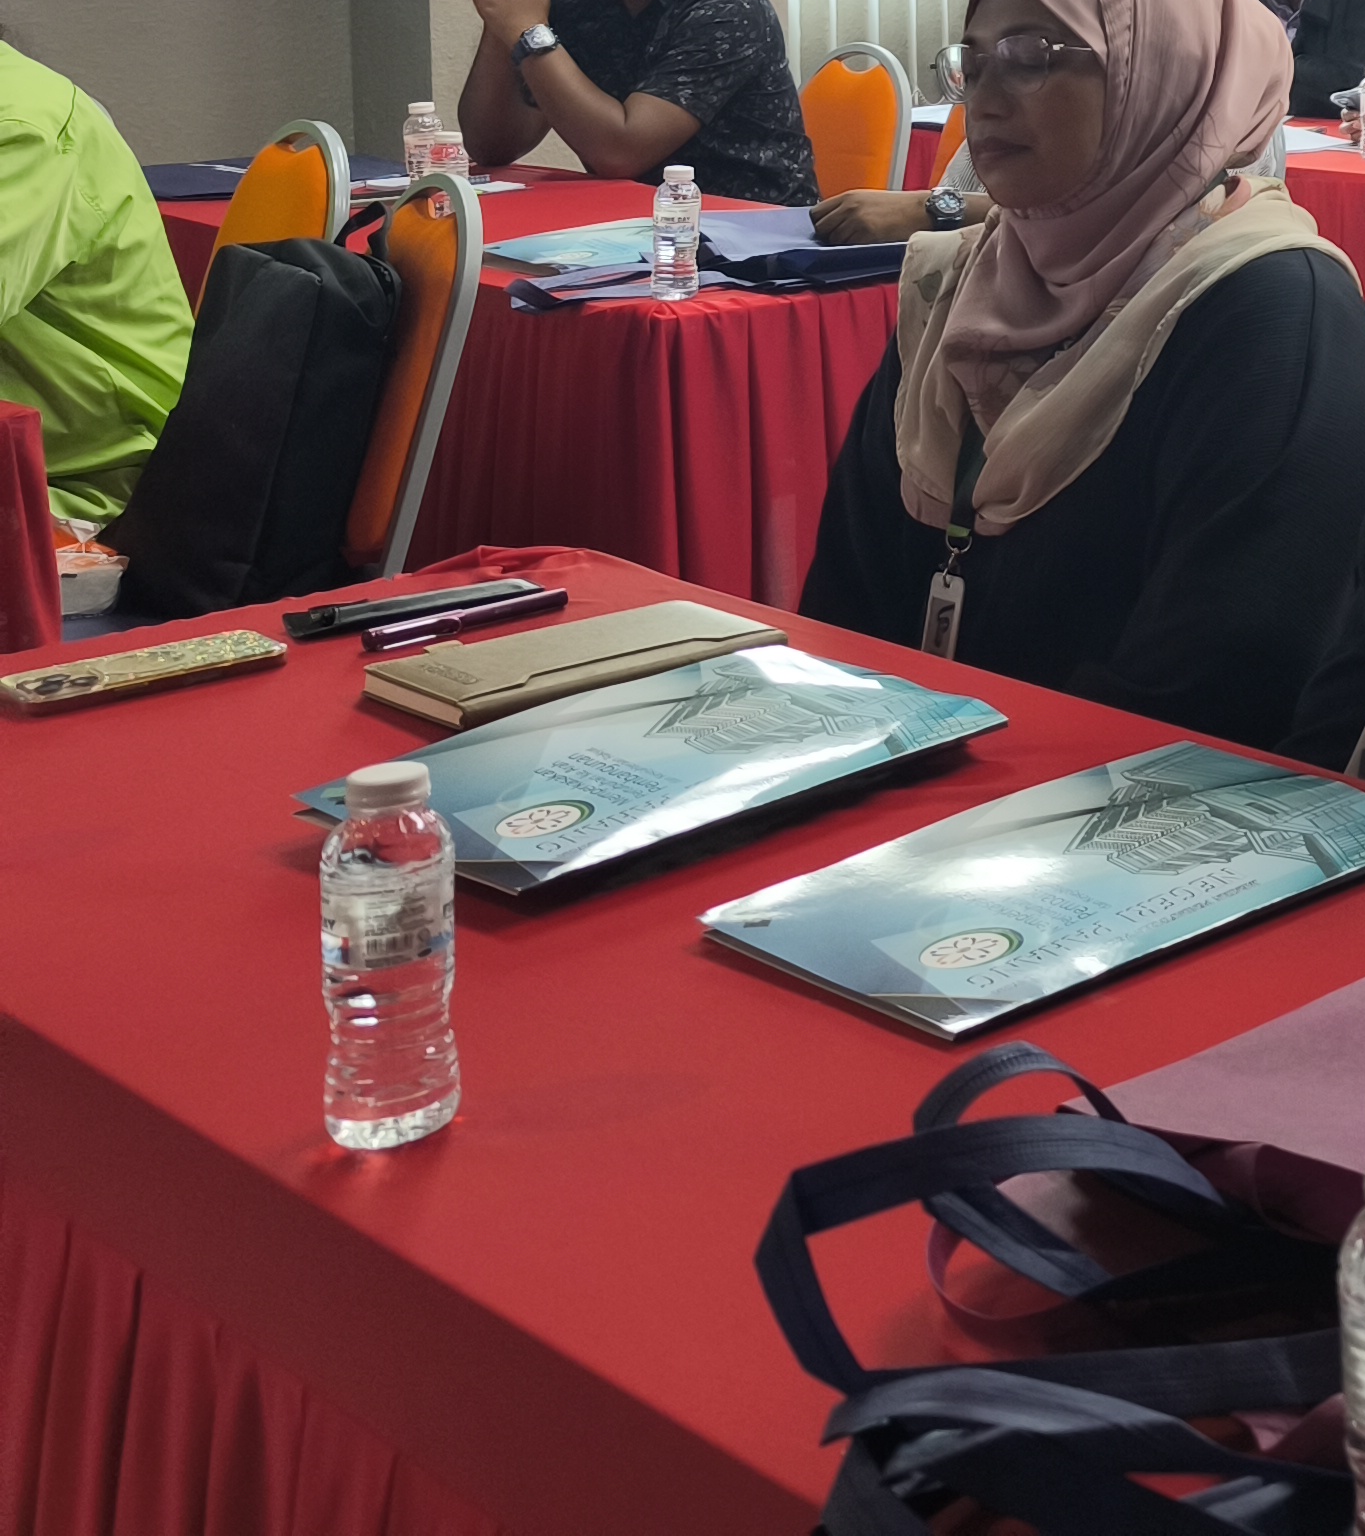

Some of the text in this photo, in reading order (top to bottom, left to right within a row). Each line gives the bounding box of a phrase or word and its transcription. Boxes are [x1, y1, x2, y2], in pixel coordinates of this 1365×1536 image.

[533, 766, 633, 806] Memperkasakan
[568, 752, 668, 793] Pembangunan
[1115, 867, 1239, 924] NEGERI
[966, 920, 1112, 989] PAHANG
